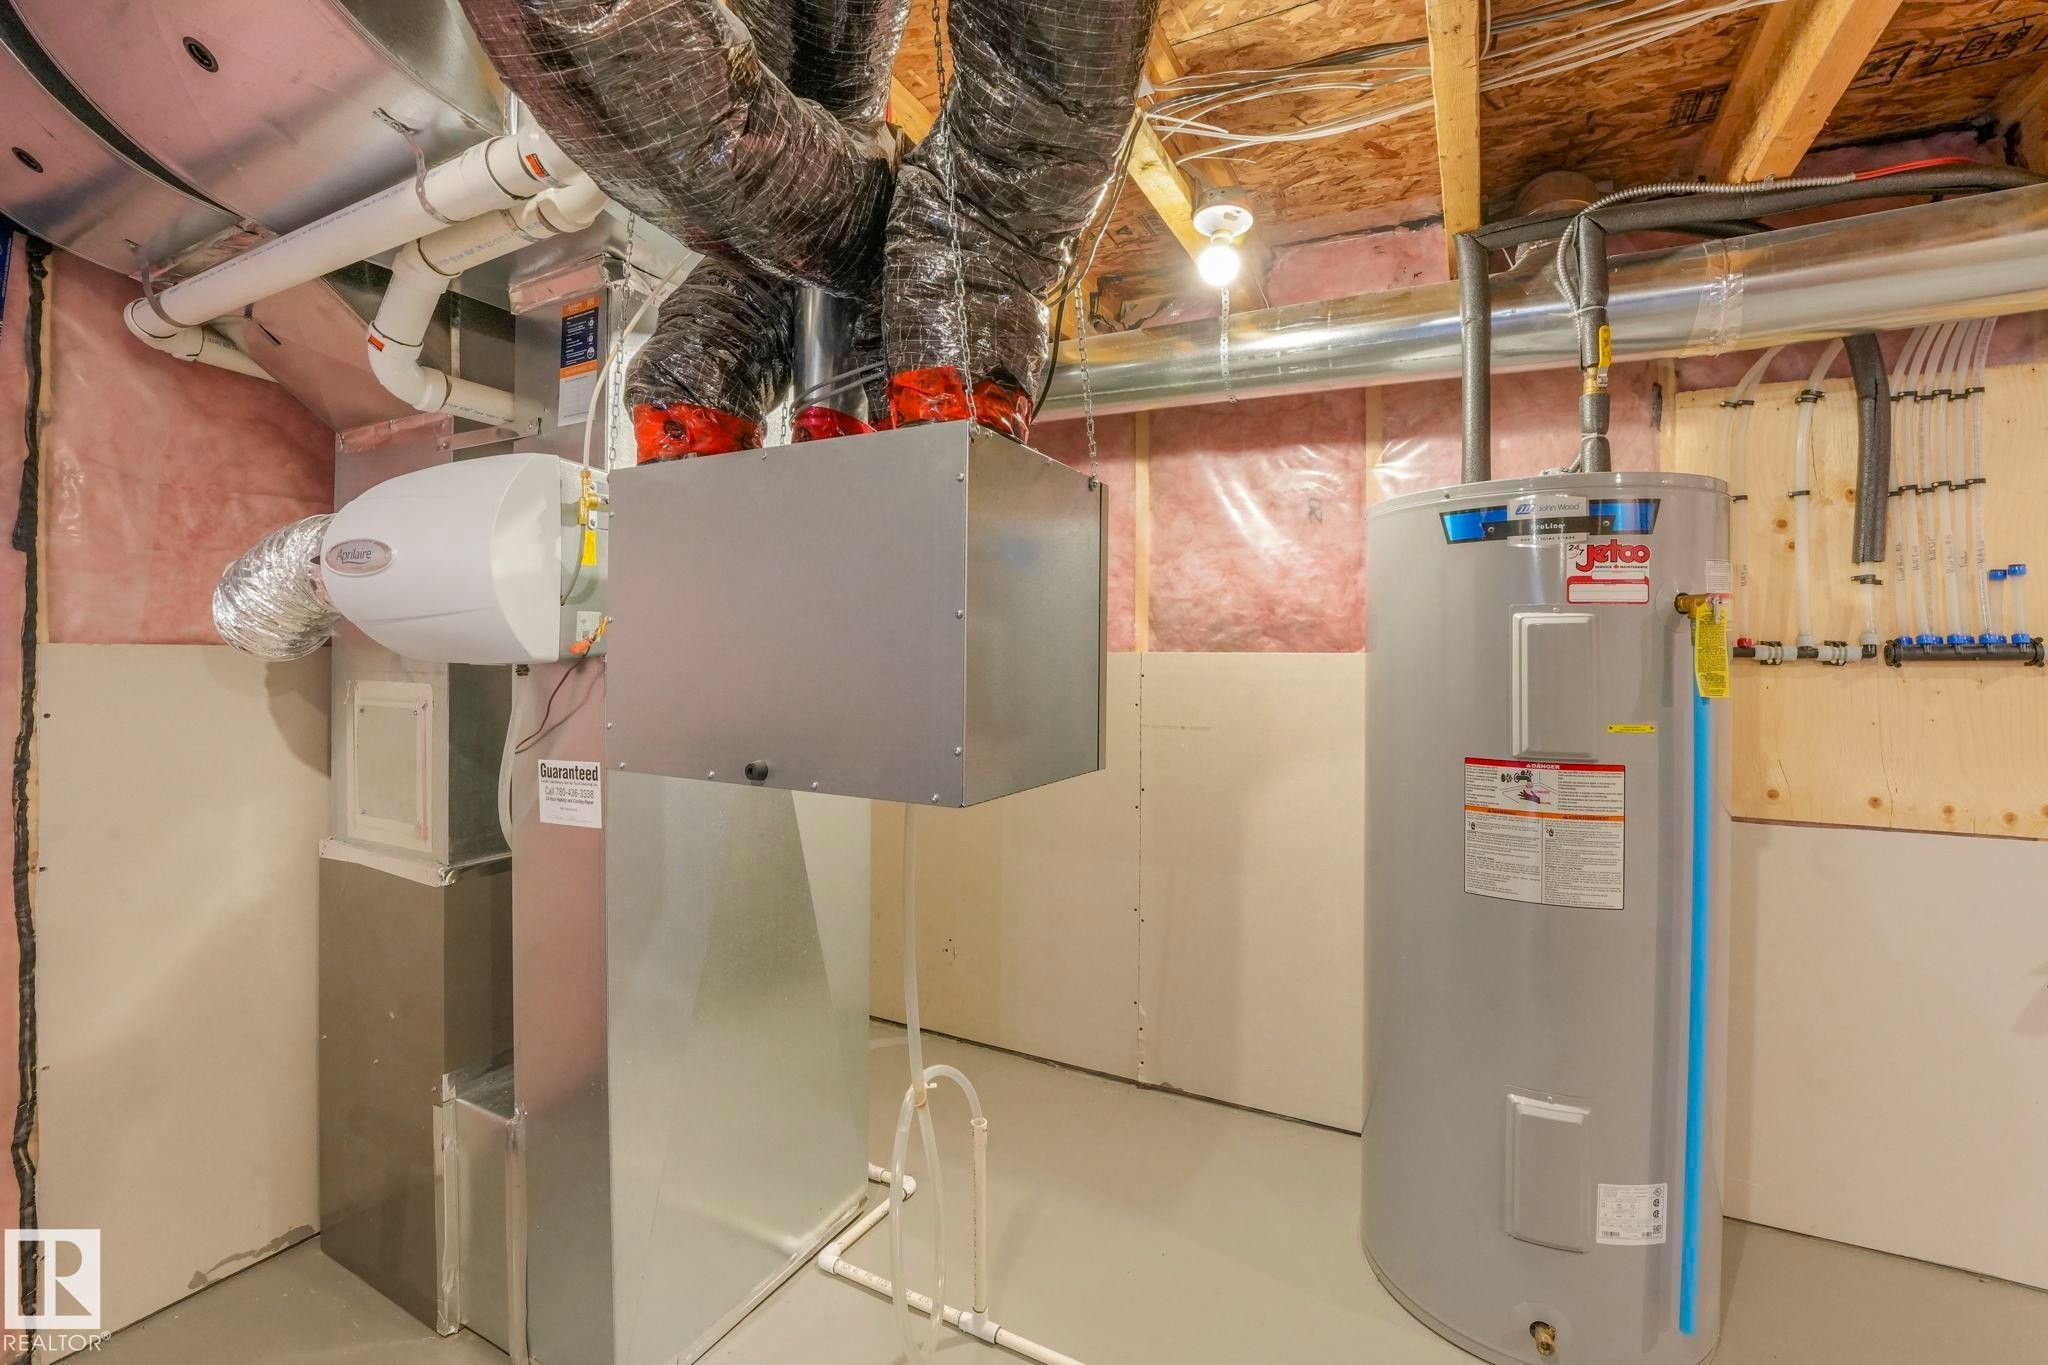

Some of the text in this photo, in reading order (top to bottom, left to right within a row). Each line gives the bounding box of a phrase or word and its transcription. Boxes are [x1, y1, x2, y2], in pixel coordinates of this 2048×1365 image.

[1538, 503, 1557, 512] John
[1557, 502, 1580, 511] Wood
[336, 548, 372, 564] Aprilaire
[540, 763, 598, 781] Guaranteed
[545, 786, 554, 795] Call
